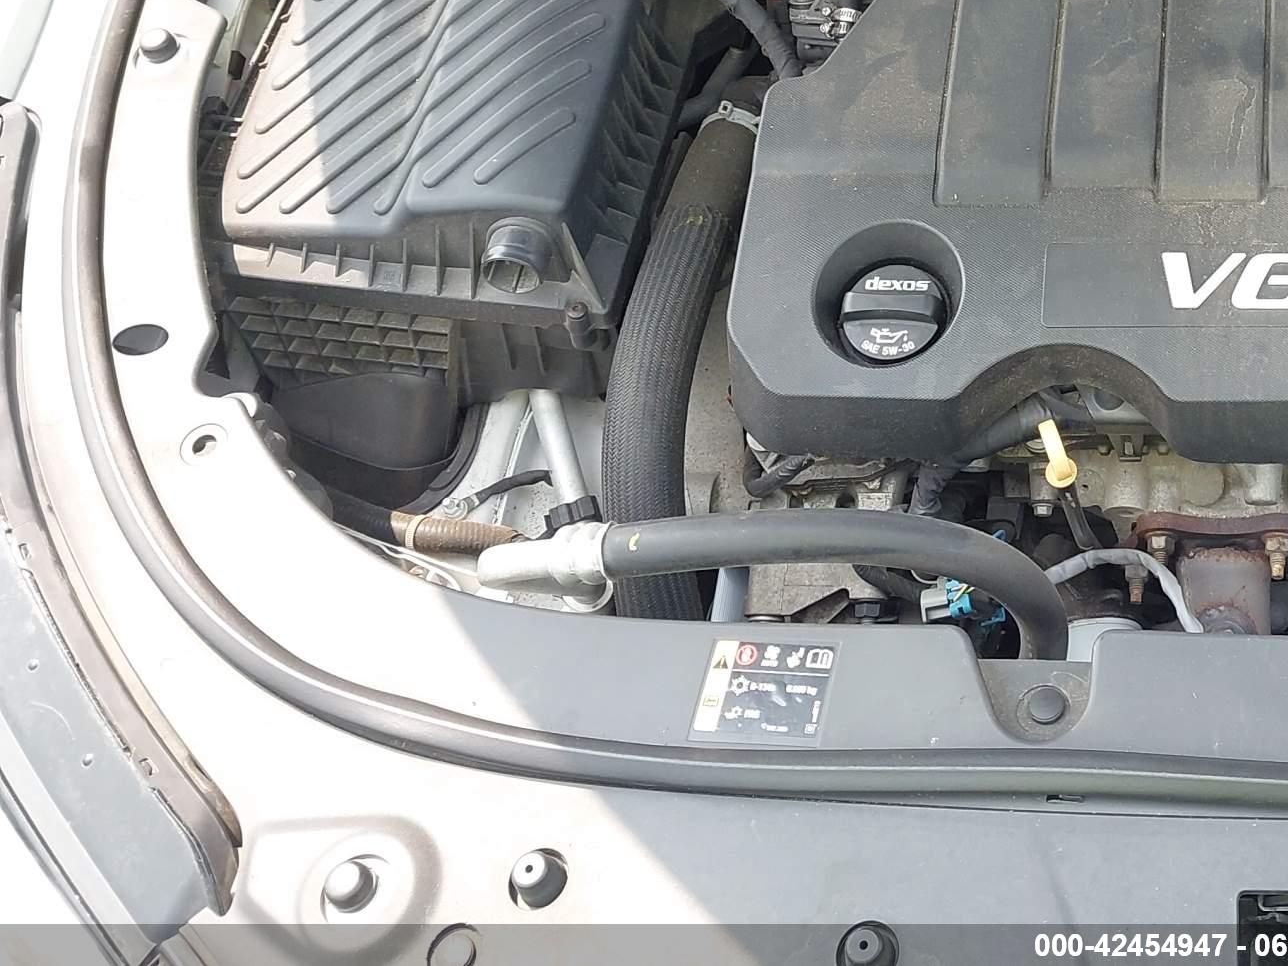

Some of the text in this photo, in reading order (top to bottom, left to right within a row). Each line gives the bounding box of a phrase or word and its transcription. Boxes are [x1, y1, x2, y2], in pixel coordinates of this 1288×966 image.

[865, 276, 931, 291] dexos
[861, 340, 915, 355] SAE 5W-30
